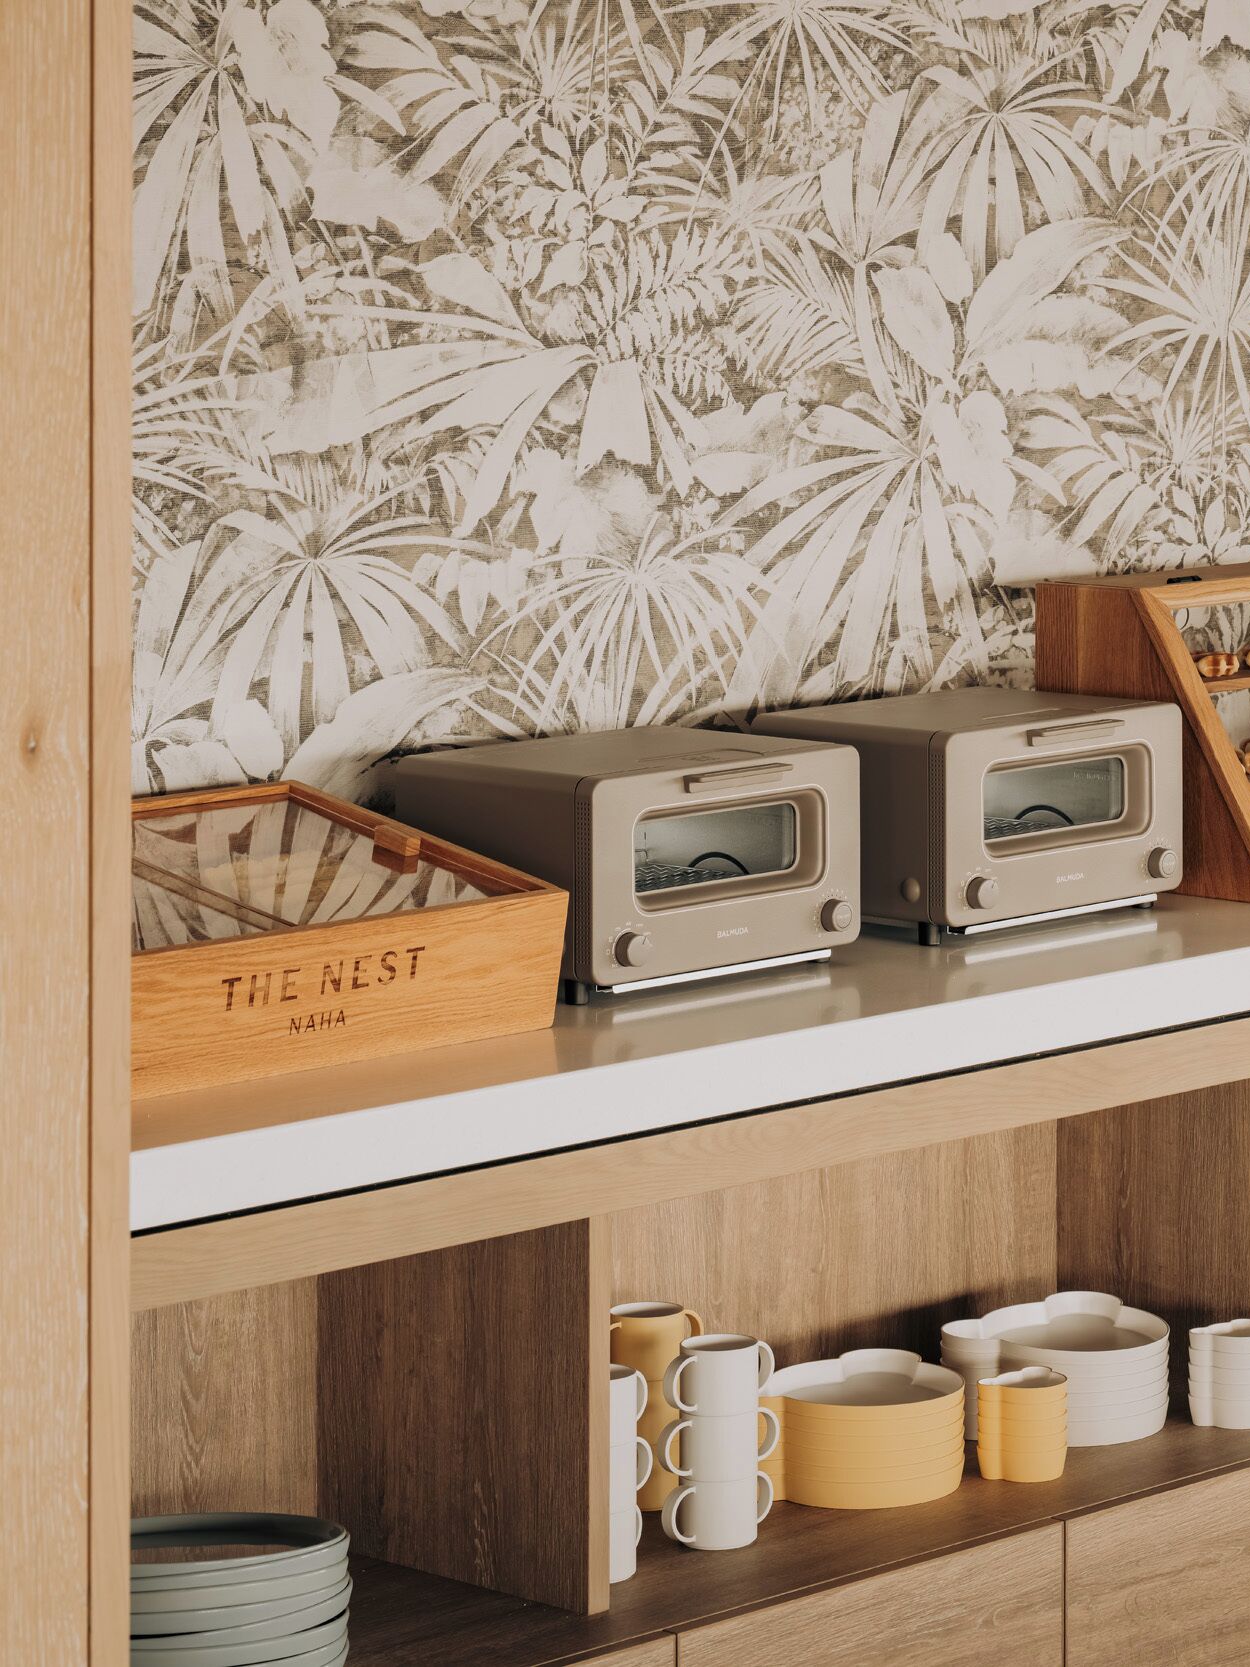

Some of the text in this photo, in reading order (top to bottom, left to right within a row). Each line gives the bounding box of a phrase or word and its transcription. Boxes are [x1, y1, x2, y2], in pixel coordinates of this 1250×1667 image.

[716, 926, 749, 939] BALMUDA
[221, 945, 426, 1012] THE NEST
[288, 1008, 347, 1036] NAHA
